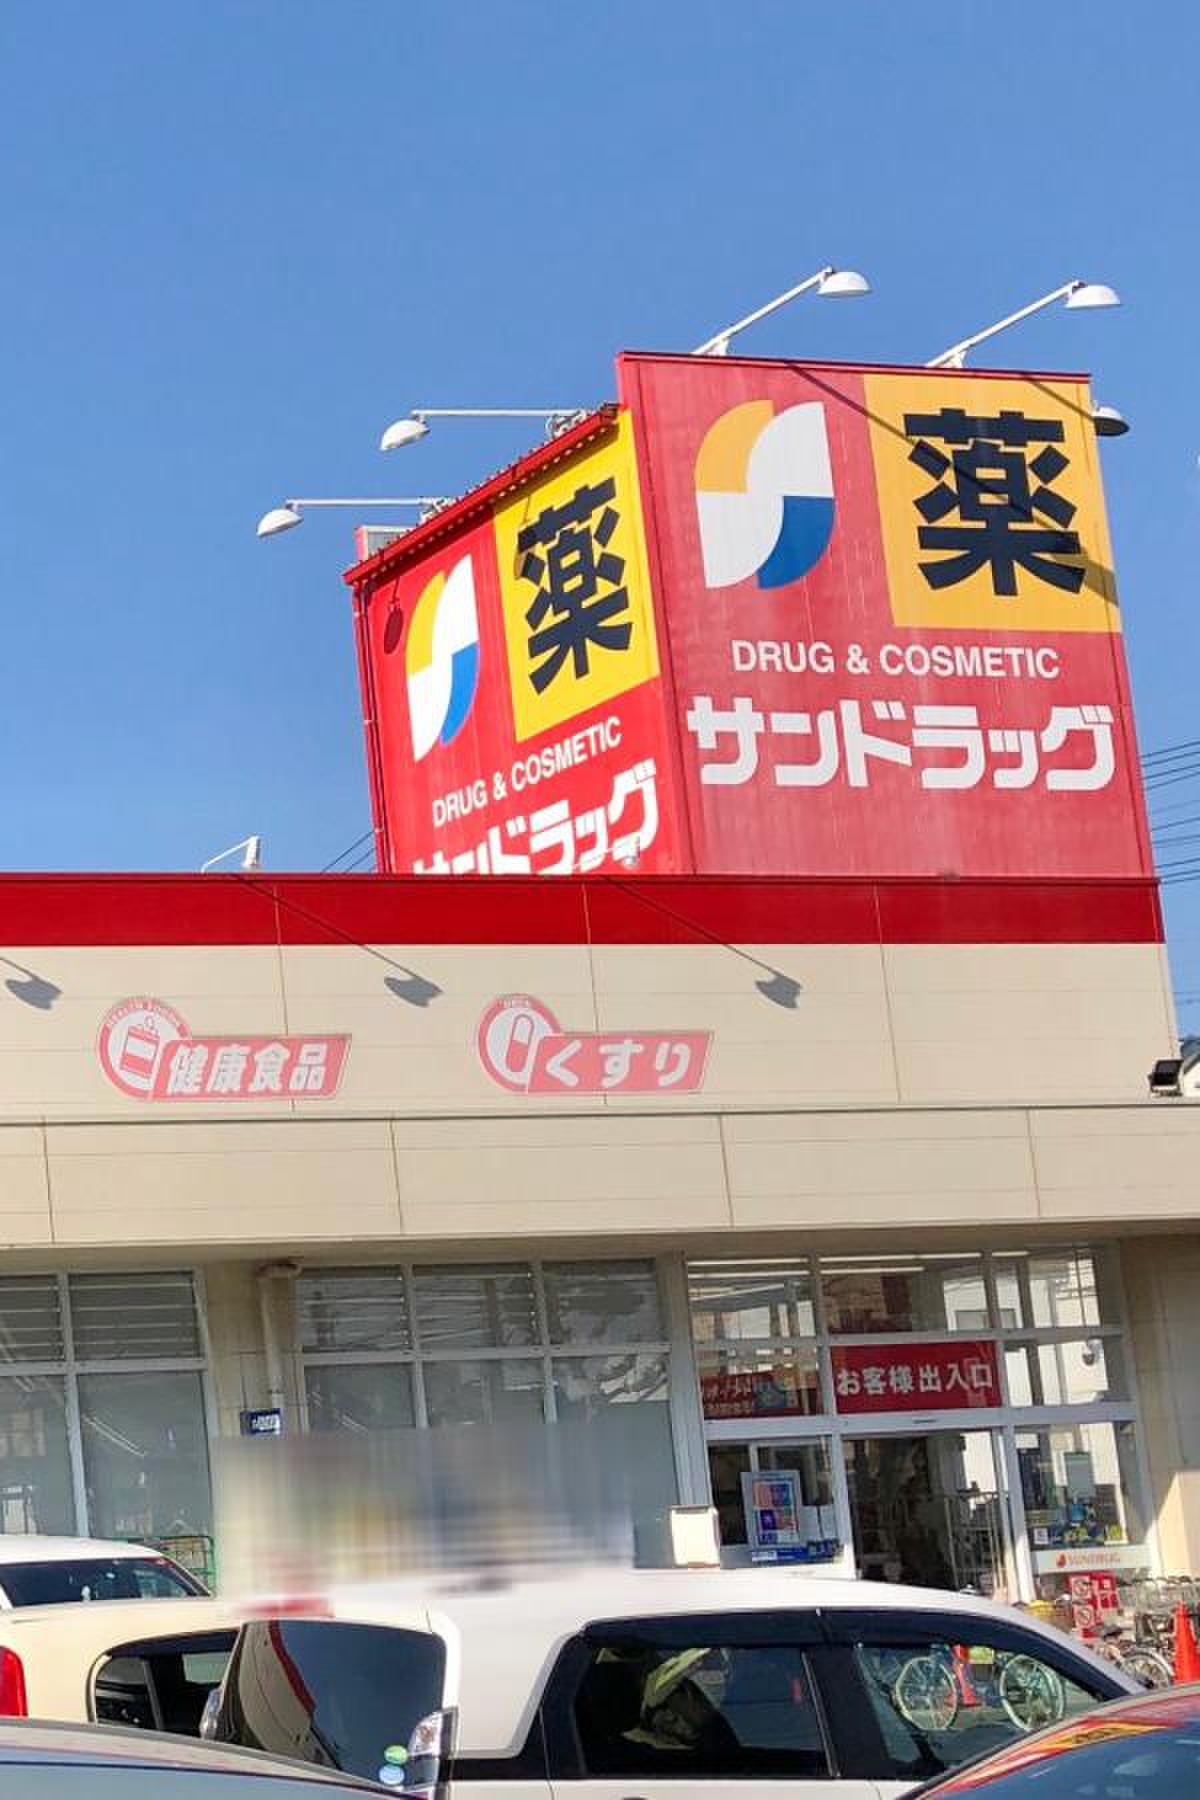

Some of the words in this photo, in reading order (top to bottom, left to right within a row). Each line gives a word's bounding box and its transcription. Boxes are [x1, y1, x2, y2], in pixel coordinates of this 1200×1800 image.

[903, 408, 1086, 596] 薬
[517, 476, 633, 695] 薬
[731, 640, 834, 673] DRUG
[846, 643, 870, 673] &
[880, 645, 1060, 679] COSMETIC
[432, 779, 487, 828] DRUG
[493, 771, 507, 801] &
[511, 716, 622, 791] COSMETIC
[688, 695, 1115, 791] サンドラッグ
[167, 1042, 328, 1095] 健康食品
[546, 1039, 691, 1087] くすり
[836, 1362, 994, 1397] お客様出入口
